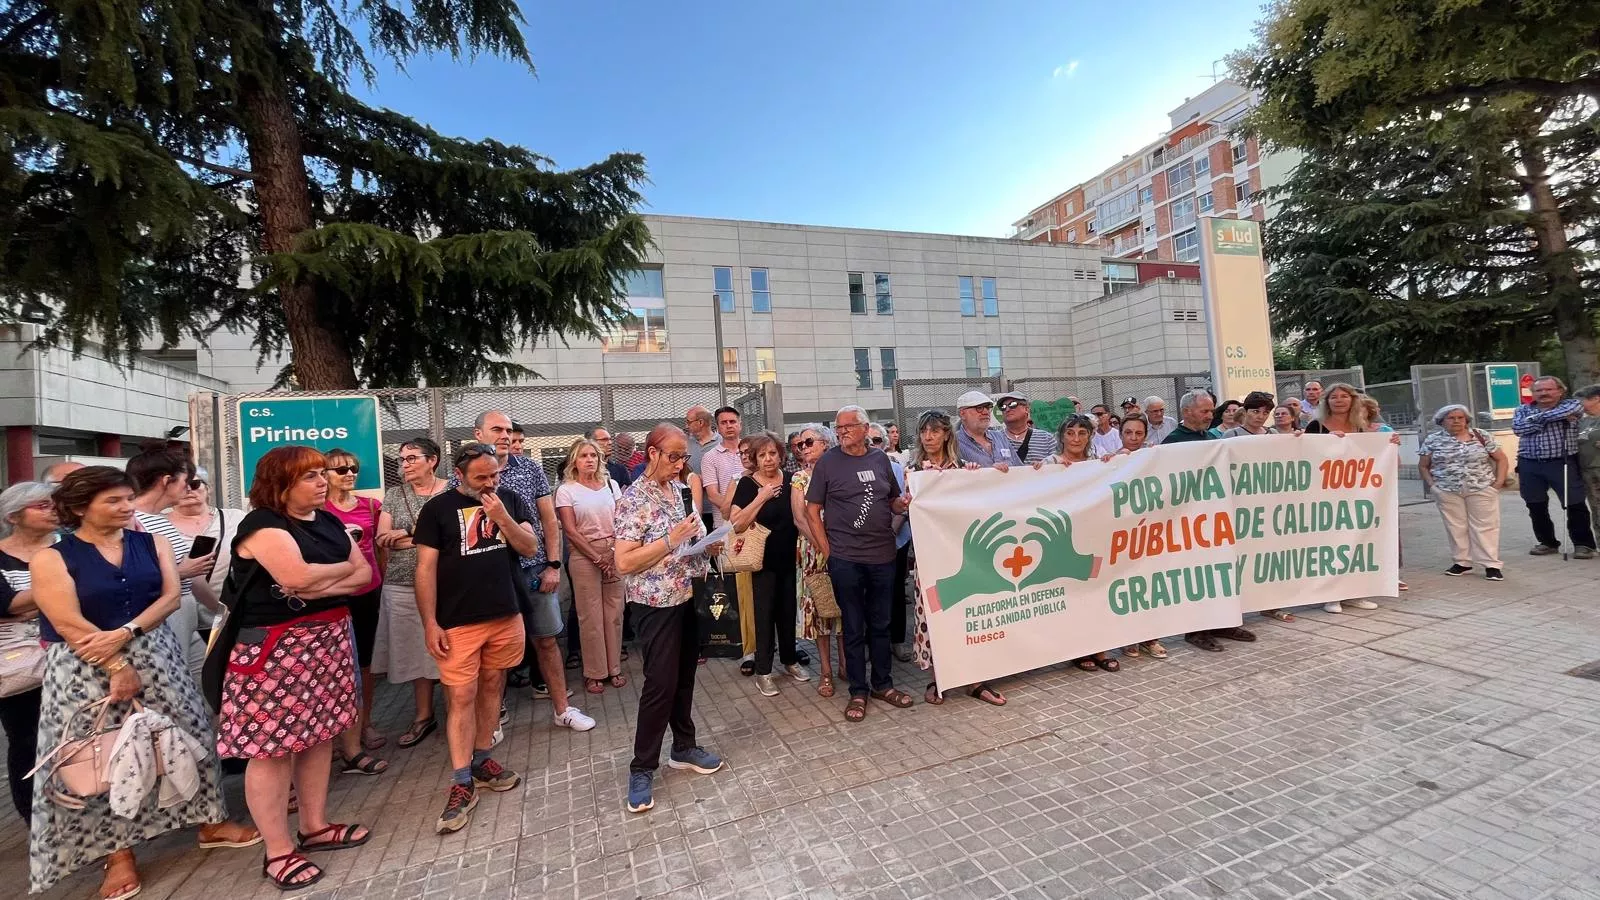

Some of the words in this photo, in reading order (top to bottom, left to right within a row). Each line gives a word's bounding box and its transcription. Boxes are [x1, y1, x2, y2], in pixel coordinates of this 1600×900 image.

[1225, 346, 1247, 358] C.S.
[1227, 366, 1271, 378] Pirineos
[249, 408, 275, 417] C.S.
[250, 426, 349, 443] Pirineos
[1110, 476, 1164, 518] POR
[1168, 466, 1226, 506] UNA
[1319, 458, 1383, 490] 100%
[1109, 511, 1236, 565] PÚBLICA
[1235, 506, 1265, 540] DE
[1272, 499, 1380, 536] CALIDAD,
[1108, 562, 1233, 615] GRATUIT
[1253, 542, 1380, 584] UNIVERSAL
[965, 596, 1018, 618] PLATAFORMA
[1019, 594, 1030, 606] EN
[1031, 586, 1065, 604] DEFENSA
[966, 620, 979, 632] DE
[981, 618, 993, 630] LA
[995, 608, 1032, 627] SANIDAD
[1033, 600, 1067, 617] PÚBLICA
[966, 630, 1005, 645] huesca
